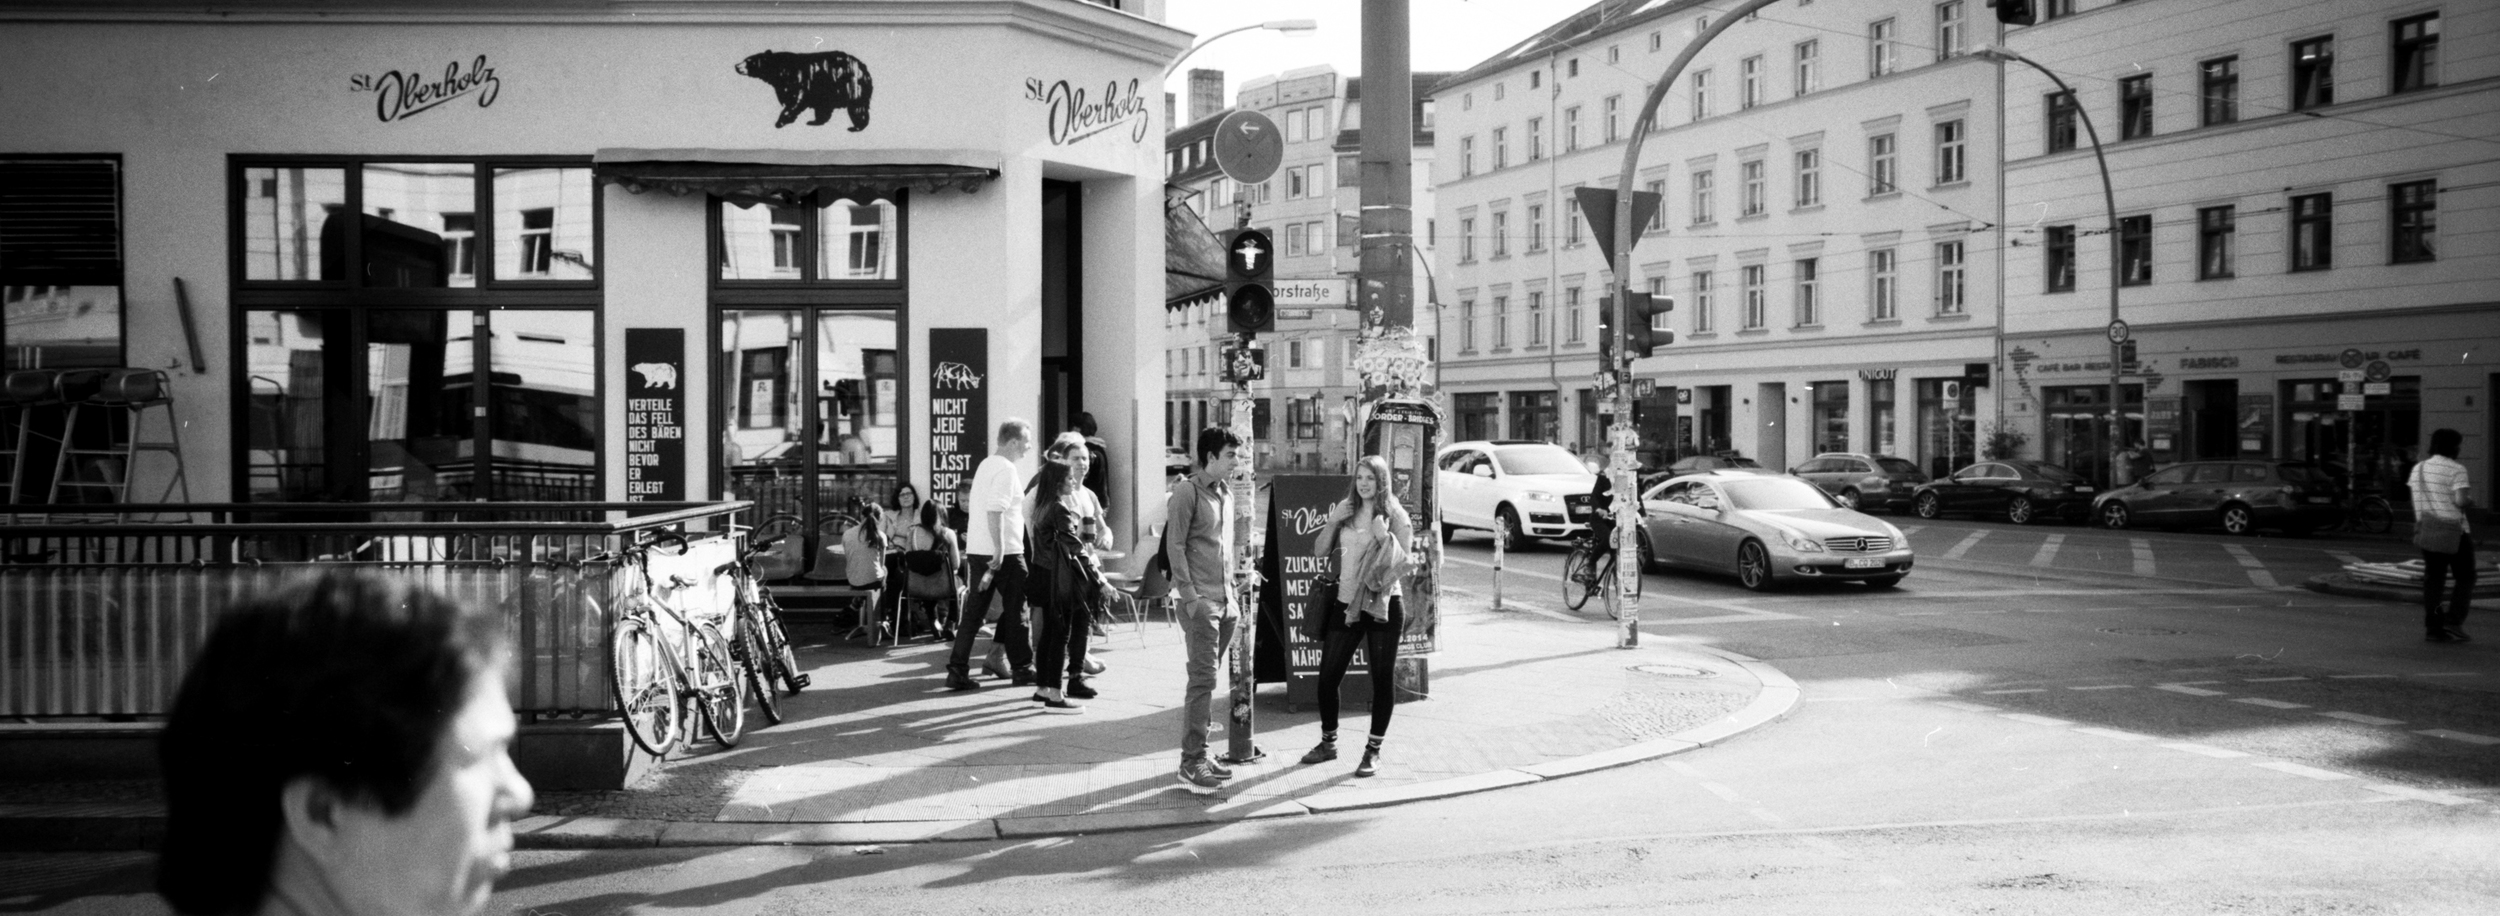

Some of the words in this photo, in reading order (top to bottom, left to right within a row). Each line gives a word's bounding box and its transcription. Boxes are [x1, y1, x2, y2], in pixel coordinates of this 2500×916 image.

[350, 74, 373, 92] St
[373, 54, 500, 122] Oberholz
[1025, 77, 1045, 101] St
[1045, 77, 1149, 146] Oberholz
[1273, 283, 1330, 301] orstraße
[2112, 327, 2124, 339] 30
[2062, 363, 2081, 372] BAR
[2180, 356, 2239, 370] FABISCH
[629, 399, 672, 411] VERTEILE
[932, 398, 968, 415] NICHT
[629, 413, 647, 424] DAS
[652, 413, 674, 424] FELL
[932, 417, 965, 434] JEDE
[1408, 414, 1434, 424] BRIDGES
[629, 427, 647, 439] DES
[652, 424, 682, 439] BÄREN
[629, 440, 656, 452] NICHT
[932, 435, 958, 452] KUH
[629, 454, 659, 466] BEVOR
[932, 451, 971, 471] LÄSST
[629, 468, 641, 480] ER
[933, 473, 961, 490] SICH
[629, 482, 664, 494] ERLEGT
[1286, 579, 1312, 596] MEH
[1288, 603, 1307, 620] SA
